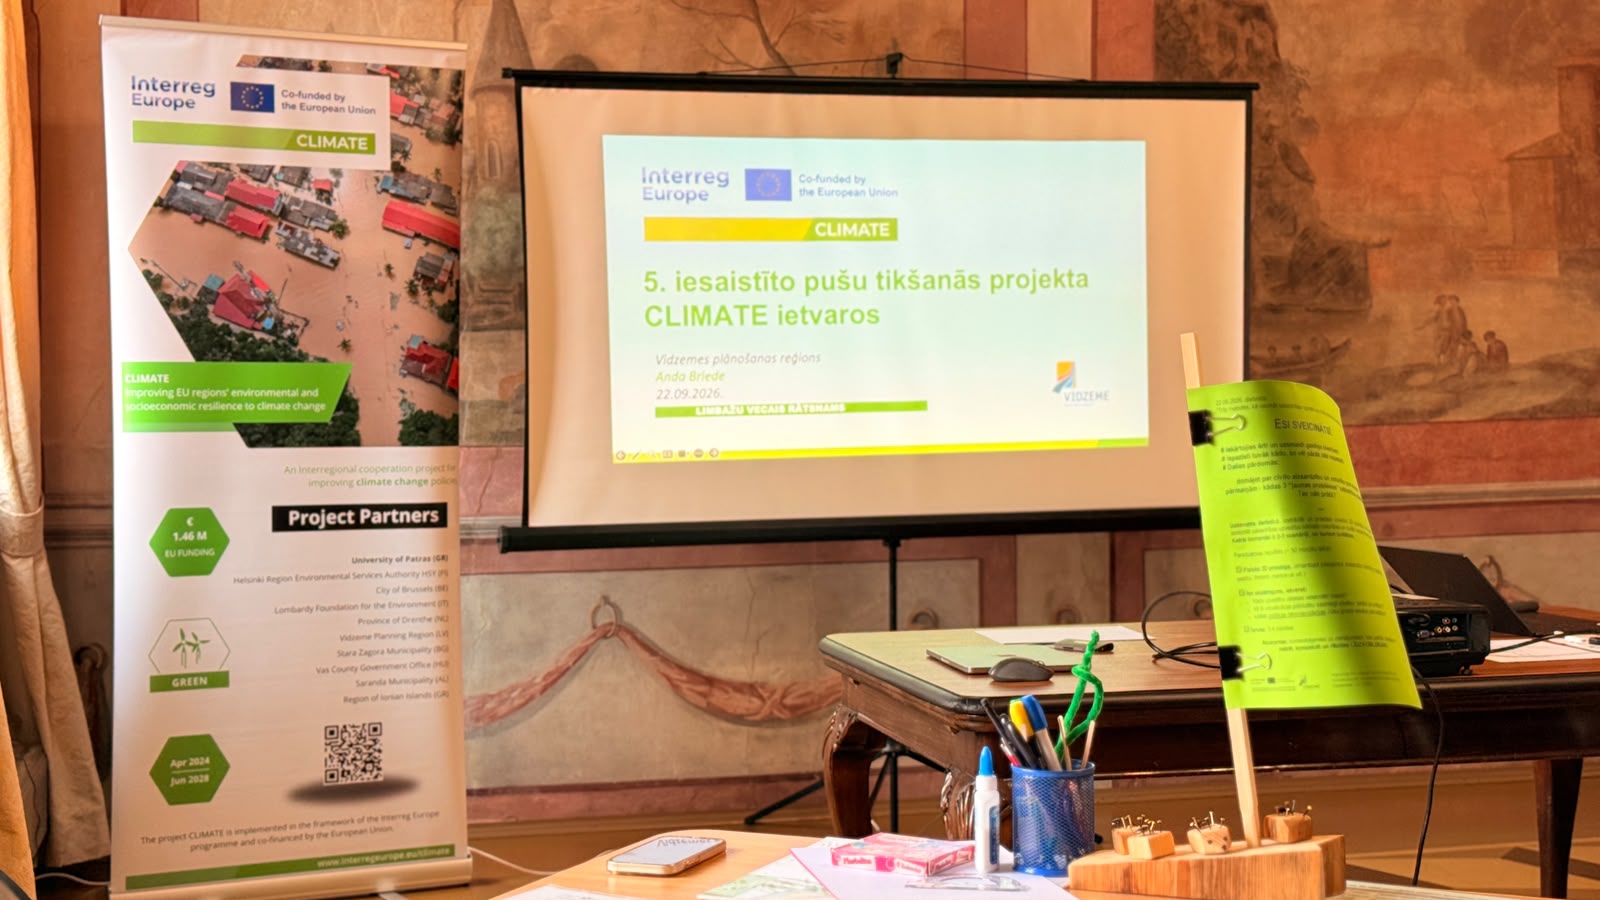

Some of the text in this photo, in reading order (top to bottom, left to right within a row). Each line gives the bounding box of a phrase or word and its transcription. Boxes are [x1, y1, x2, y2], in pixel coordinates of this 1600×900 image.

[131, 75, 215, 97] Interreg
[131, 93, 196, 110] Europe
[281, 88, 345, 103] Co-funded by
[281, 102, 376, 115] the European Union
[296, 134, 368, 151] CLIMATE
[641, 166, 730, 187] Interreg
[799, 174, 865, 187] Co-funded by
[642, 187, 709, 204] Europe
[799, 187, 898, 198] the European Union
[815, 222, 890, 238] CLIMATE
[644, 268, 1089, 296] 5. iesaistīto pušu tikšanās projekta
[644, 304, 880, 327] CLIMATE ietvaros
[655, 352, 822, 368] Vidzemes plānošanas reģions
[125, 373, 169, 383] CLIMATE
[656, 371, 725, 382] Anda Briede
[125, 387, 175, 399] Improving
[176, 387, 190, 397] EU
[231, 387, 298, 398] environmental
[301, 387, 319, 398] and
[656, 388, 725, 400] 22.09.2026.
[1063, 391, 1110, 402] VIDZEME
[125, 400, 326, 412] socioeconomic resilience to climate change
[284, 465, 297, 474] An
[298, 464, 357, 475] Interregional
[358, 464, 414, 475] cooperation
[415, 464, 446, 475] project
[308, 478, 354, 488] improving
[356, 477, 393, 487] climate
[394, 477, 429, 488] change
[186, 517, 194, 526] €
[288, 507, 440, 529] Project Partners
[173, 531, 207, 541] 1.46 M
[165, 548, 215, 558] EU FUNDING
[352, 556, 393, 565] University
[405, 555, 431, 563] Patras
[433, 555, 449, 563] (GR)
[233, 575, 264, 584] Helsinki
[266, 575, 293, 585] Region
[295, 573, 350, 583] Environmental
[352, 572, 383, 580] Services
[385, 571, 420, 580] Authority
[376, 586, 391, 596] City
[435, 585, 449, 593] (BE)
[274, 605, 314, 615] Lombardy
[316, 603, 359, 612] Foundation
[361, 602, 372, 610] for
[374, 602, 385, 610] the
[388, 600, 436, 609] Environment
[358, 617, 390, 626] Province
[339, 630, 449, 642] Vidzeme Planning Region (LV)
[337, 649, 357, 658] Stara
[358, 648, 385, 658] Zagora
[387, 646, 432, 656] Municipality
[316, 666, 330, 675] Vas
[331, 665, 358, 675] County
[360, 663, 407, 672] Government
[409, 661, 431, 670] Office
[171, 677, 208, 688] GREEN
[355, 679, 387, 688] Saranda
[389, 677, 433, 687] Municipality
[343, 690, 449, 705] Region of Ionian Islands (GR)
[170, 757, 210, 770] Apr 2024
[170, 774, 210, 787] Jun 2028
[141, 811, 440, 846] The project CLIMATE is implemented in the framework of the Interreg Europe
[190, 825, 394, 851] programme and co-financed by the European Union.
